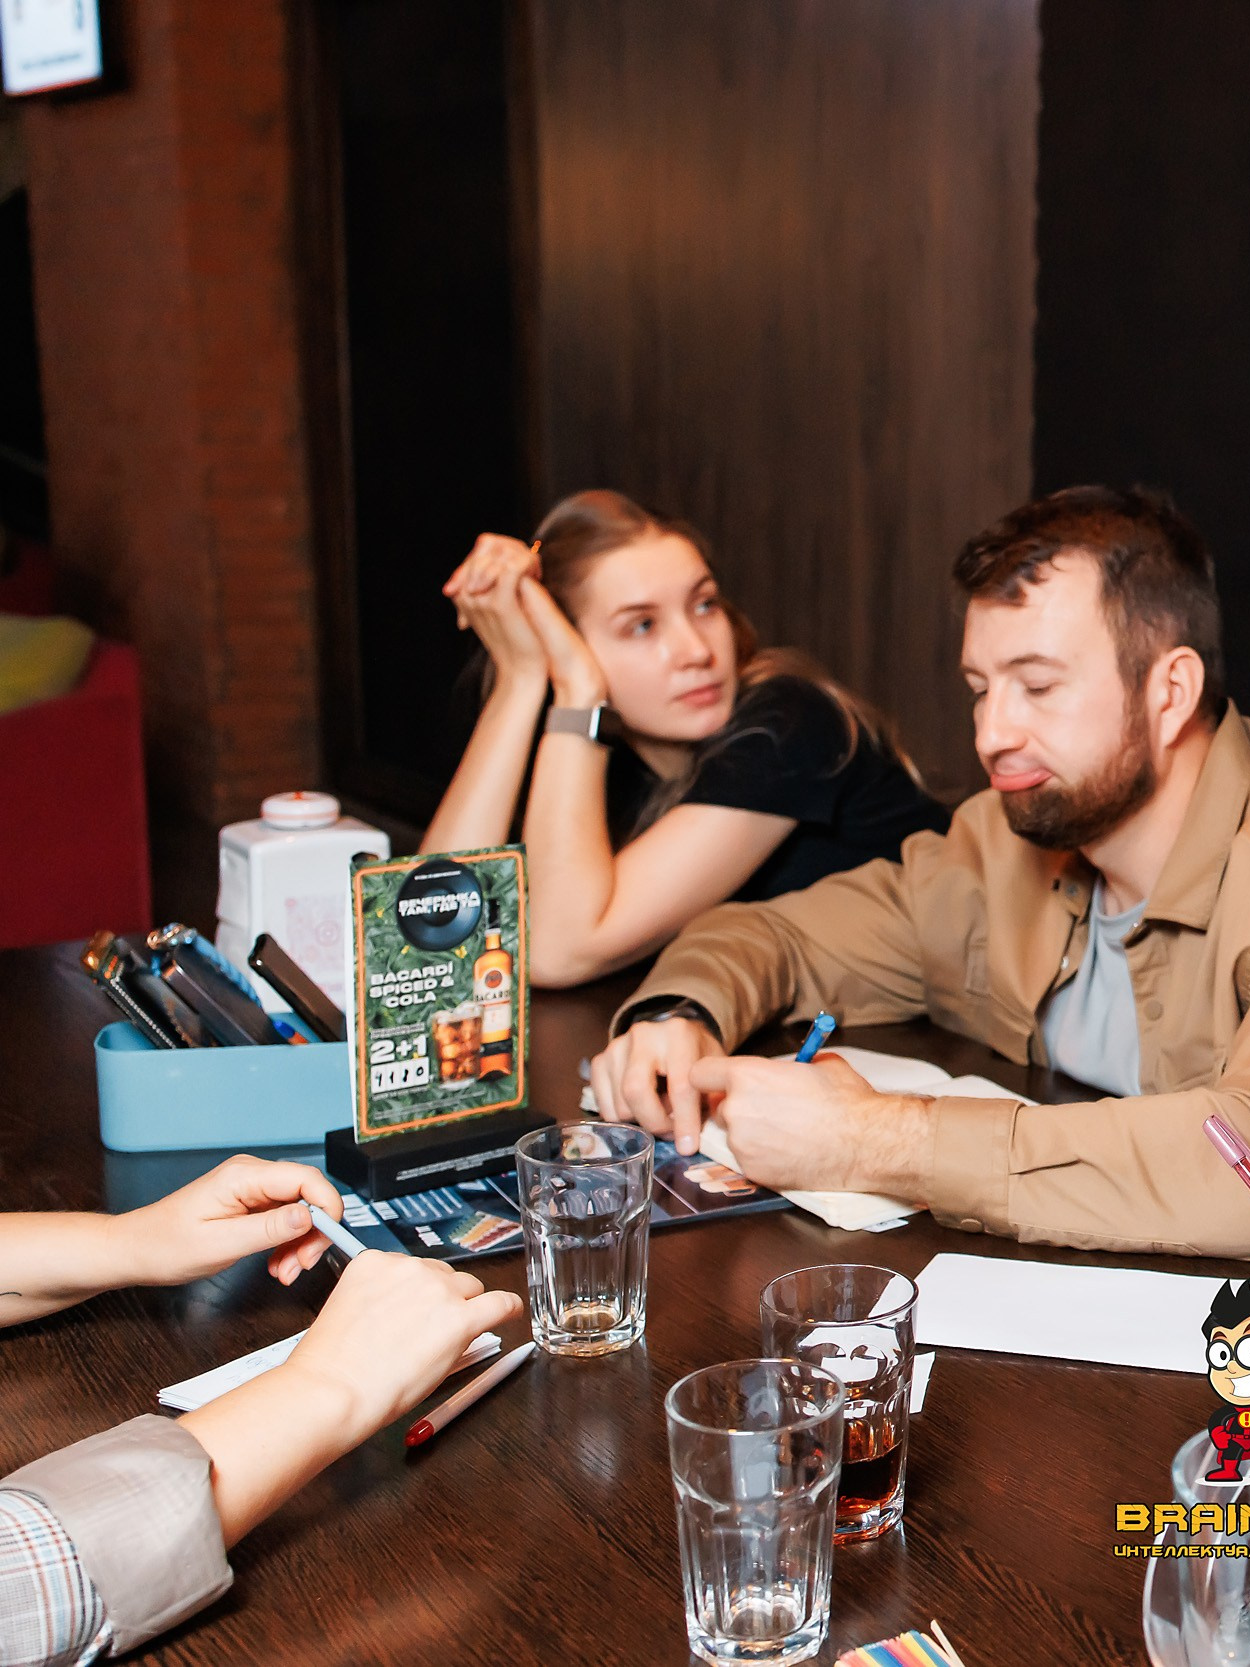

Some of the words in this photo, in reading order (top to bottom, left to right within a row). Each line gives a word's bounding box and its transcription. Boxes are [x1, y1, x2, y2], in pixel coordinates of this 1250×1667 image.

[369, 977, 438, 998] SPICED
[385, 991, 437, 1008] COLA
[370, 1033, 428, 1065] 2+1
